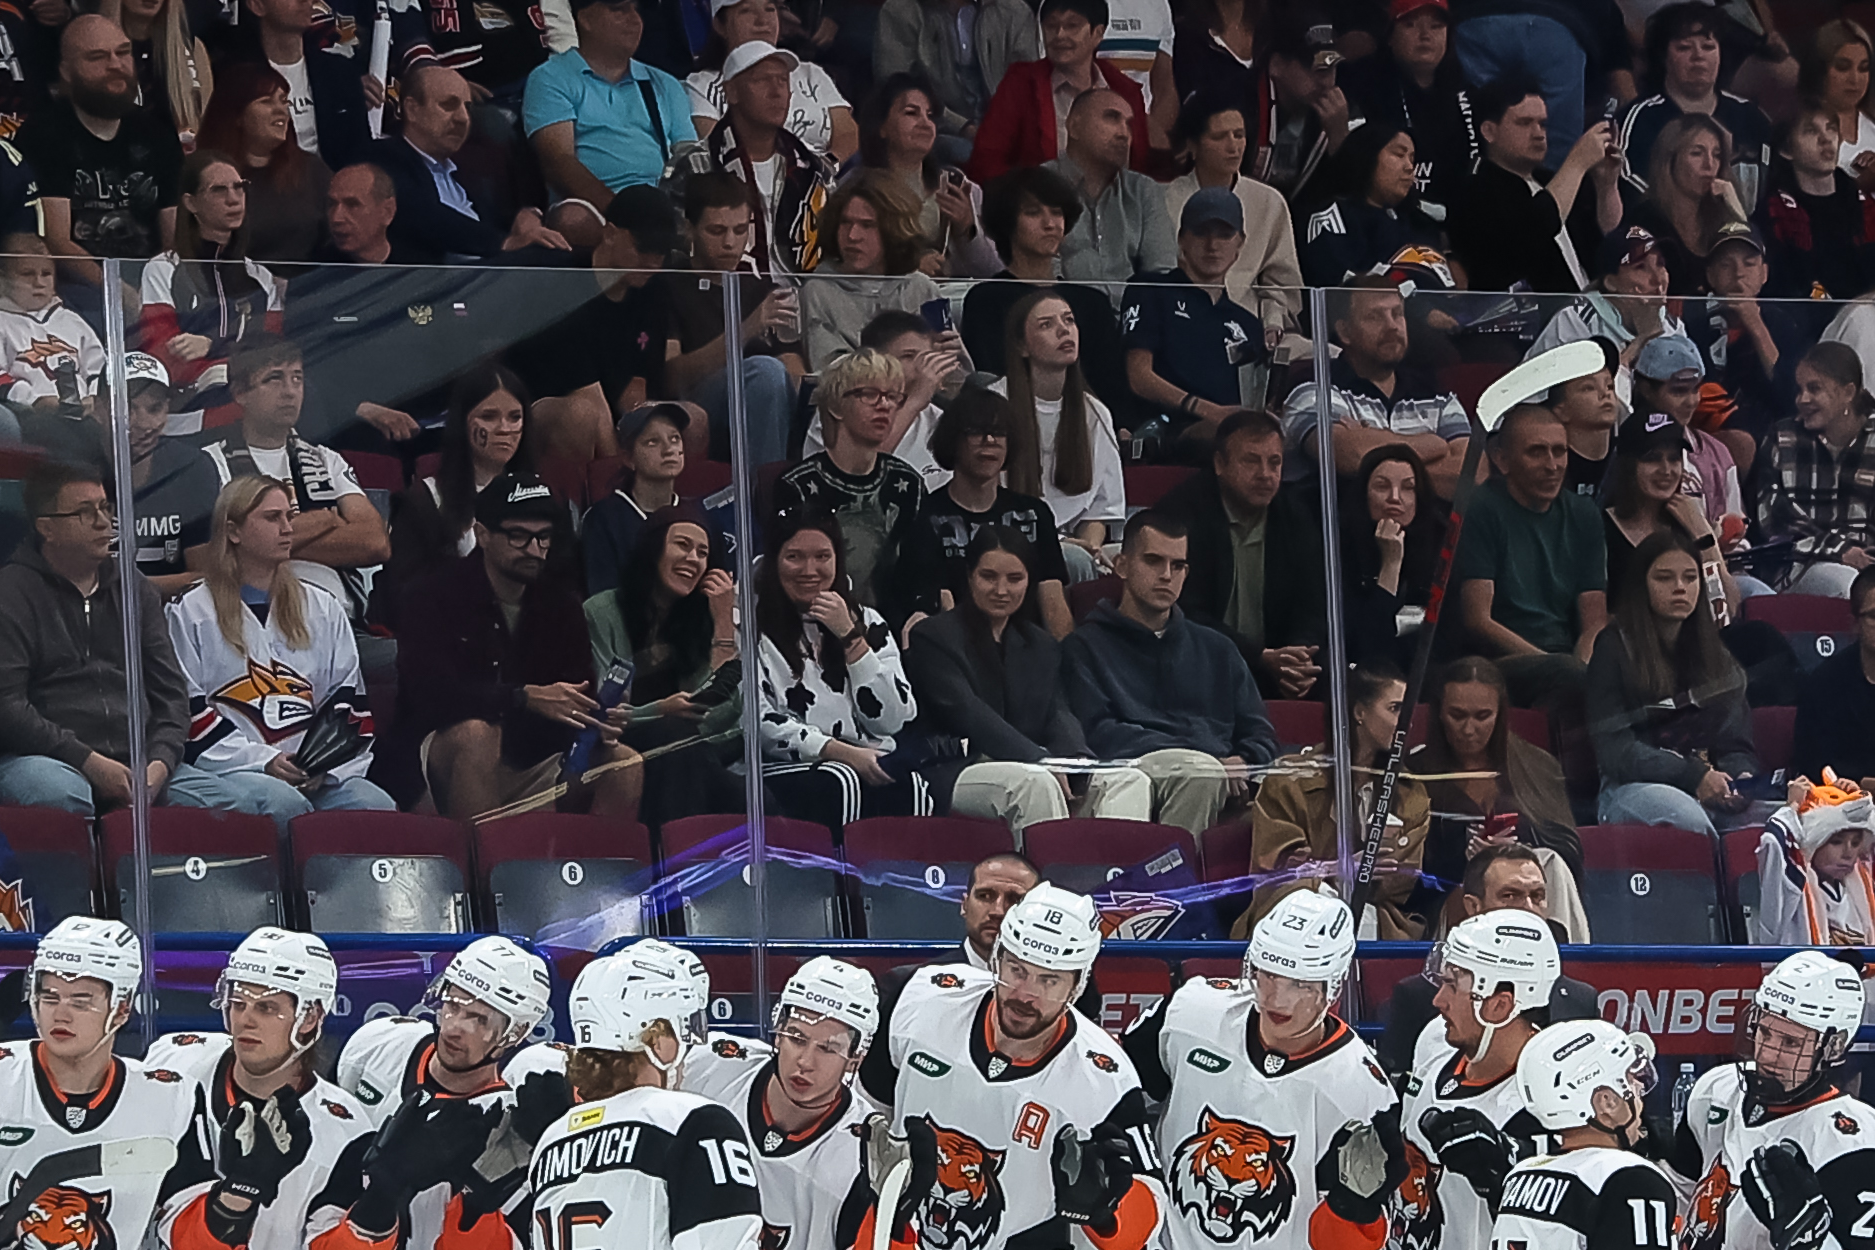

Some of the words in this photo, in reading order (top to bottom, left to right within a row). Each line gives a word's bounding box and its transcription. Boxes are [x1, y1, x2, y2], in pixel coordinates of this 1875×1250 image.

[1631, 875, 1649, 893] 12
[1044, 908, 1063, 926] 18
[1282, 914, 1308, 932] 23
[45, 949, 81, 964] согаз
[1022, 935, 1060, 957] согаз
[1260, 950, 1298, 969] согаз
[457, 967, 493, 992] согаз
[805, 990, 843, 1012] согаз
[579, 1023, 594, 1044] 16
[1012, 1101, 1051, 1151] A
[697, 1138, 757, 1188] 16
[1626, 1198, 1669, 1248] 11
